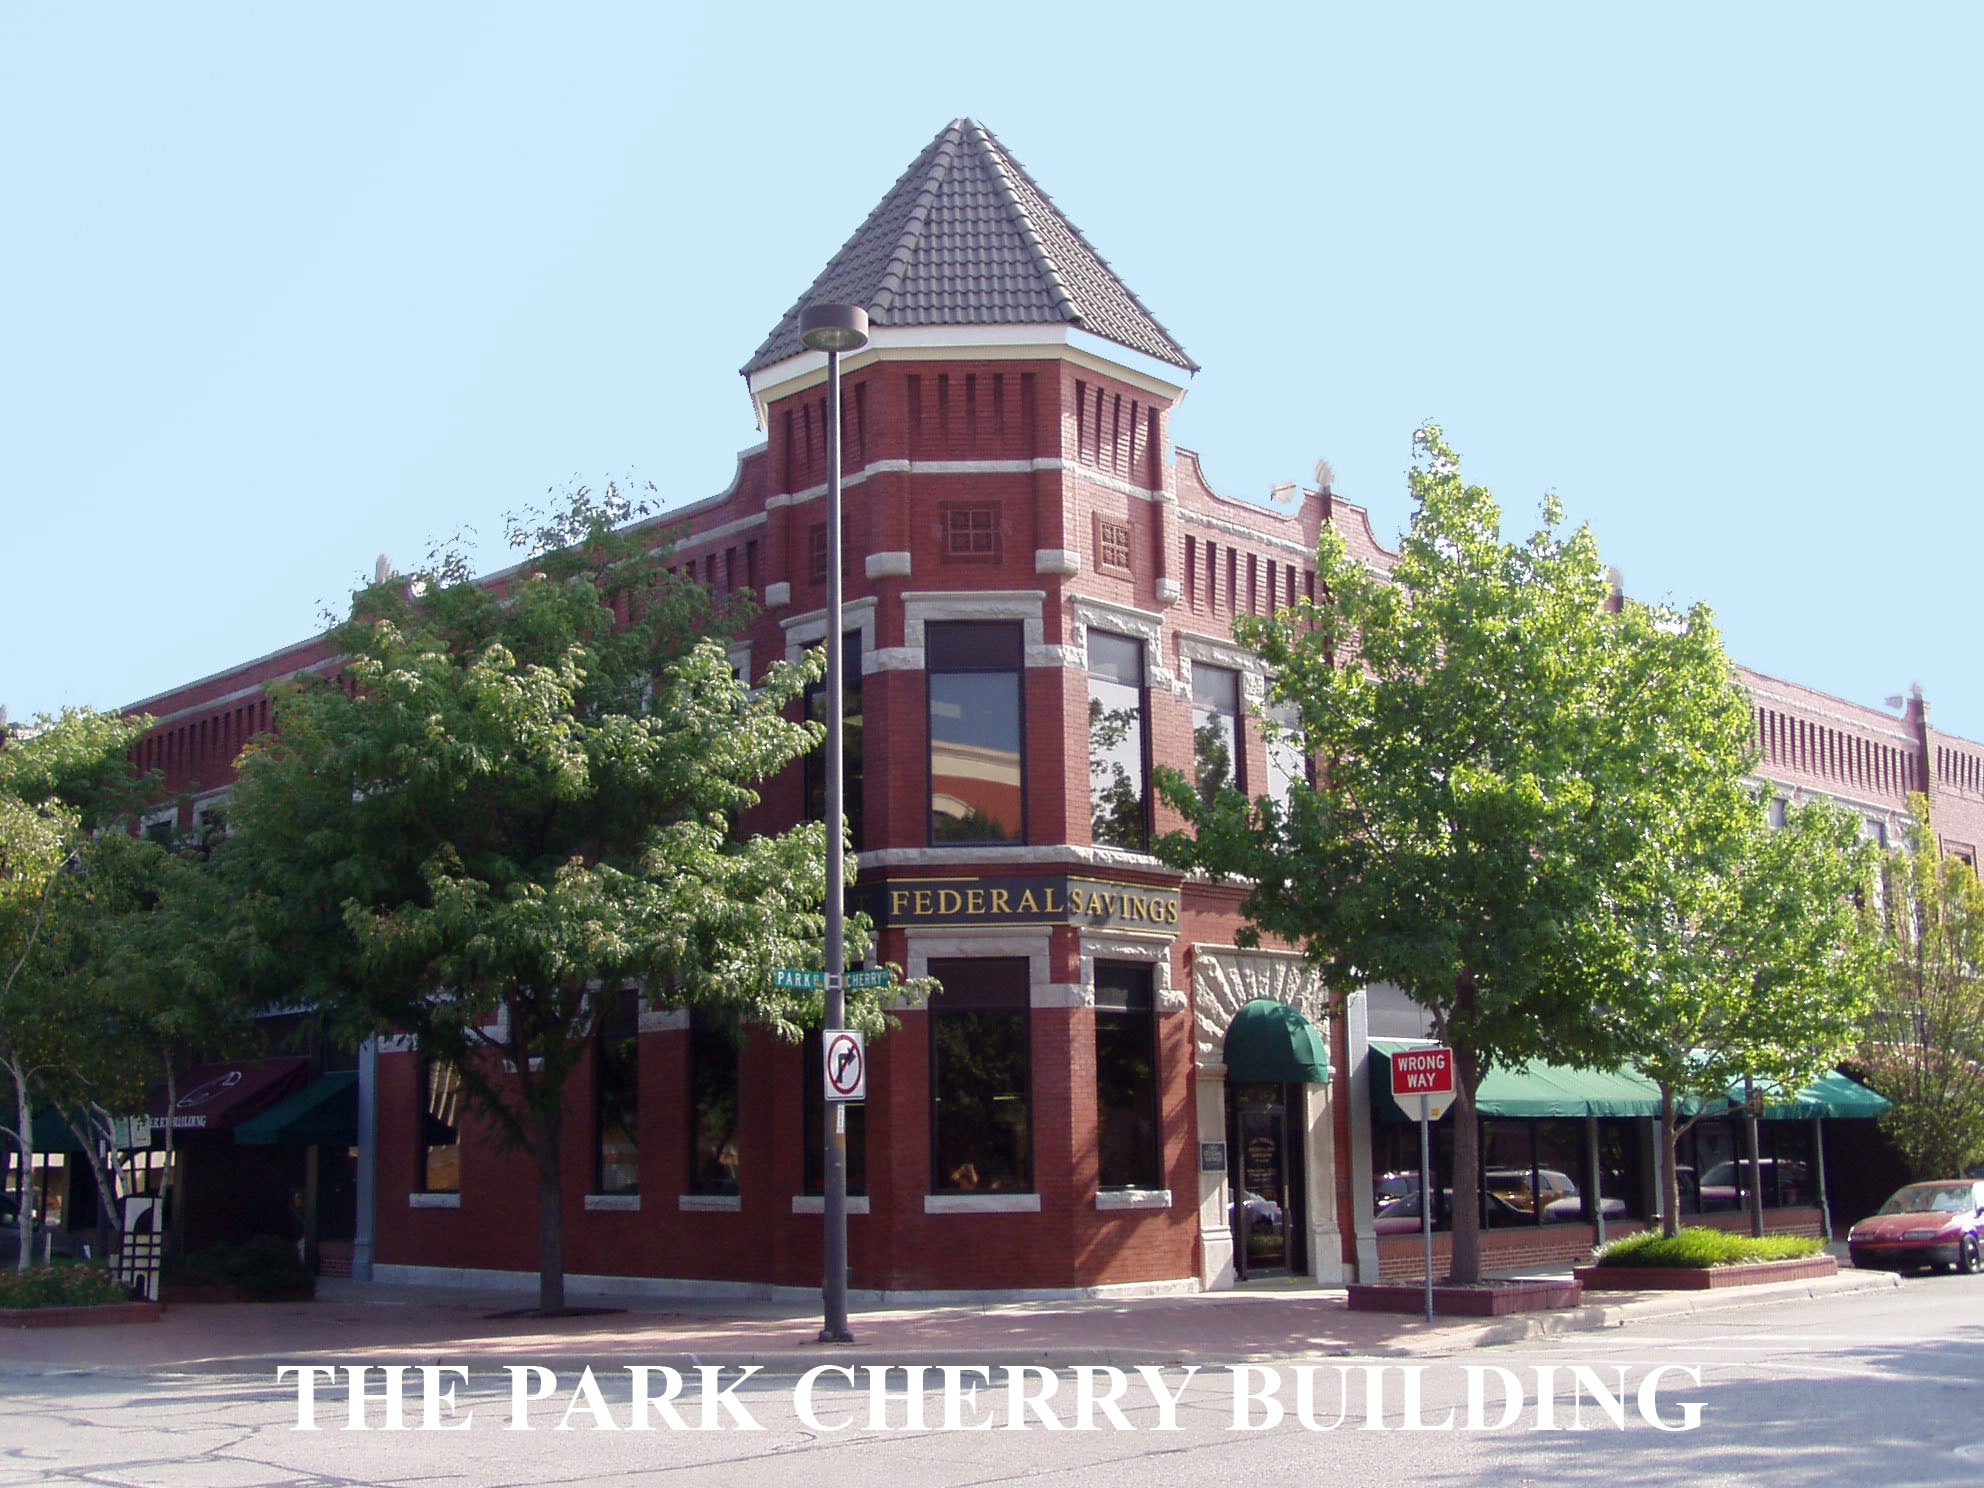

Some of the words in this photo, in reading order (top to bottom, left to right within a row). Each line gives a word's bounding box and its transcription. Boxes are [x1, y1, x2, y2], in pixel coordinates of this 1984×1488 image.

[890, 888, 1065, 915] FEDERAL
[1070, 888, 1179, 924] SAVINGS
[778, 971, 811, 987] PARK
[847, 971, 881, 987] CHERRY
[1398, 1055, 1446, 1071] WRONG
[1407, 1073, 1436, 1088] WAY
